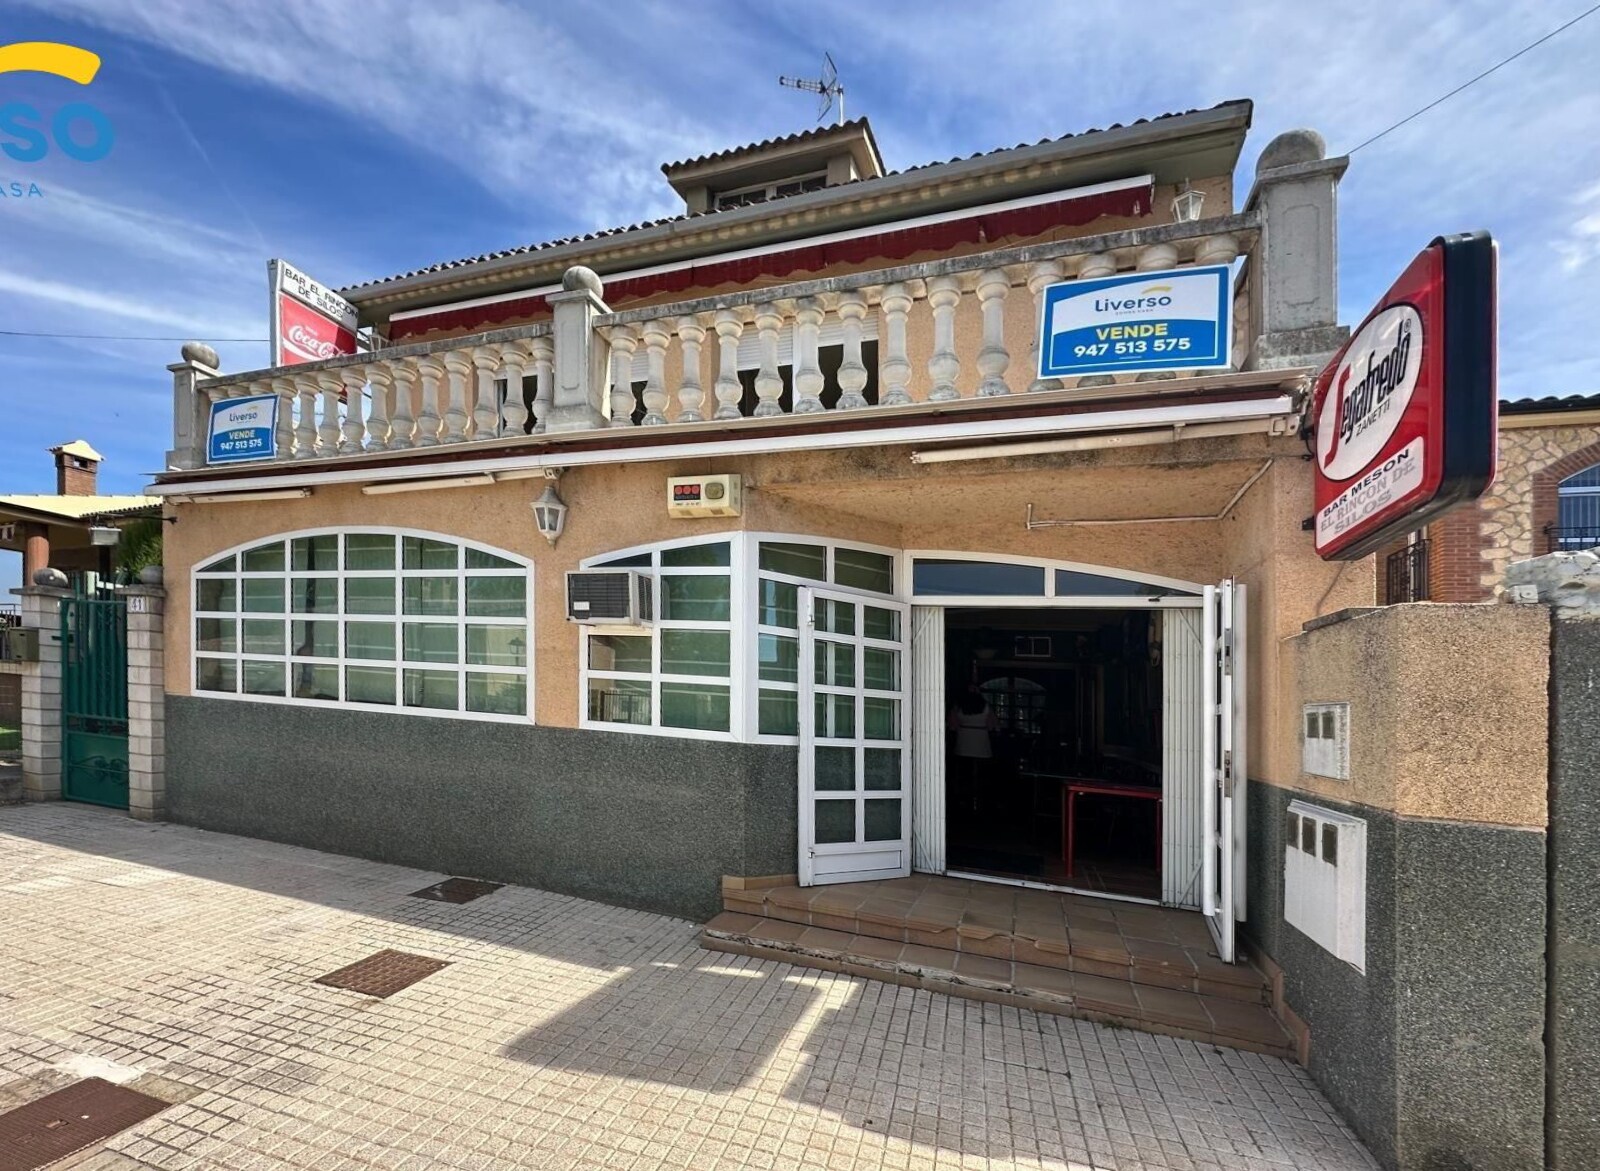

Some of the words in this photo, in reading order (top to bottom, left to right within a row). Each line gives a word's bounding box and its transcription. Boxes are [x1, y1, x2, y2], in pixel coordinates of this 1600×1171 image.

[285, 268, 306, 287] BAR
[310, 283, 321, 297] EL
[325, 292, 358, 318] RINCON
[298, 286, 311, 299] DE
[317, 298, 344, 319] SILOS
[1095, 296, 1172, 313] Liverso
[1074, 344, 1109, 358] 947
[1114, 340, 1147, 354] 513
[1153, 337, 1191, 351] 575
[1096, 323, 1168, 340] VENDE
[1324, 320, 1411, 469] Segafredo
[229, 412, 258, 422] Liverso
[1355, 398, 1391, 436] ZANETTI
[220, 442, 234, 451] 947
[235, 440, 248, 449] 513
[249, 438, 262, 448] 575
[229, 430, 255, 440] VENDE
[1321, 515, 1335, 533] EL
[1337, 477, 1388, 520] RINCON
[1392, 457, 1416, 483] DE
[1323, 494, 1348, 517] BAR
[1351, 448, 1409, 496] MESON
[1334, 489, 1393, 534] SILOS
